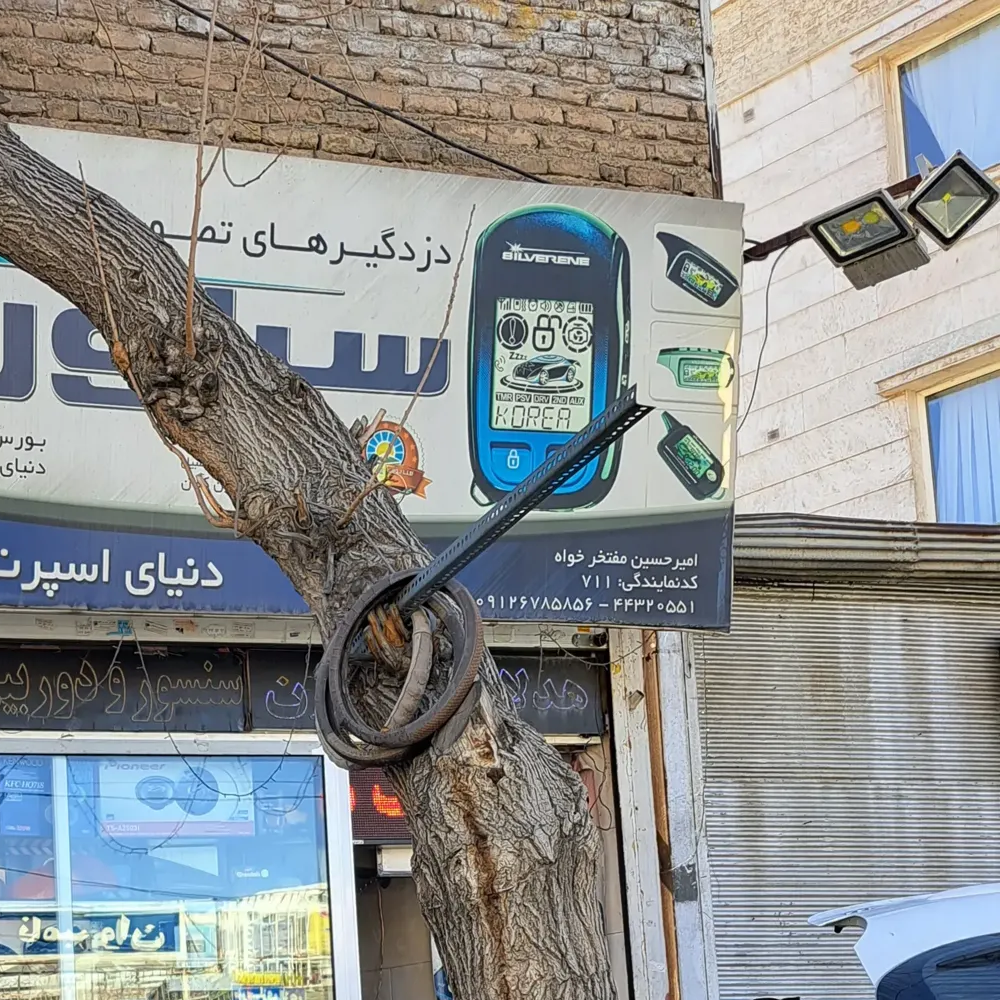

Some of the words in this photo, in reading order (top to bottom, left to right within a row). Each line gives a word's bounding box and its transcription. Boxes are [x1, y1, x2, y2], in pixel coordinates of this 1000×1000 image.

[242, 221, 451, 272] دزدگیرهای
[496, 392, 513, 401] TMR
[515, 393, 532, 402] PSV
[533, 394, 550, 403] DRV
[551, 395, 567, 404] 2ND
[569, 396, 585, 405] AUX
[495, 405, 571, 430] KOREA
[0, 457, 46, 478] دنیای
[554, 548, 585, 564] خواه
[588, 550, 627, 567] مفتخر
[125, 552, 224, 598] دنیای
[133, 660, 244, 722] سنسور
